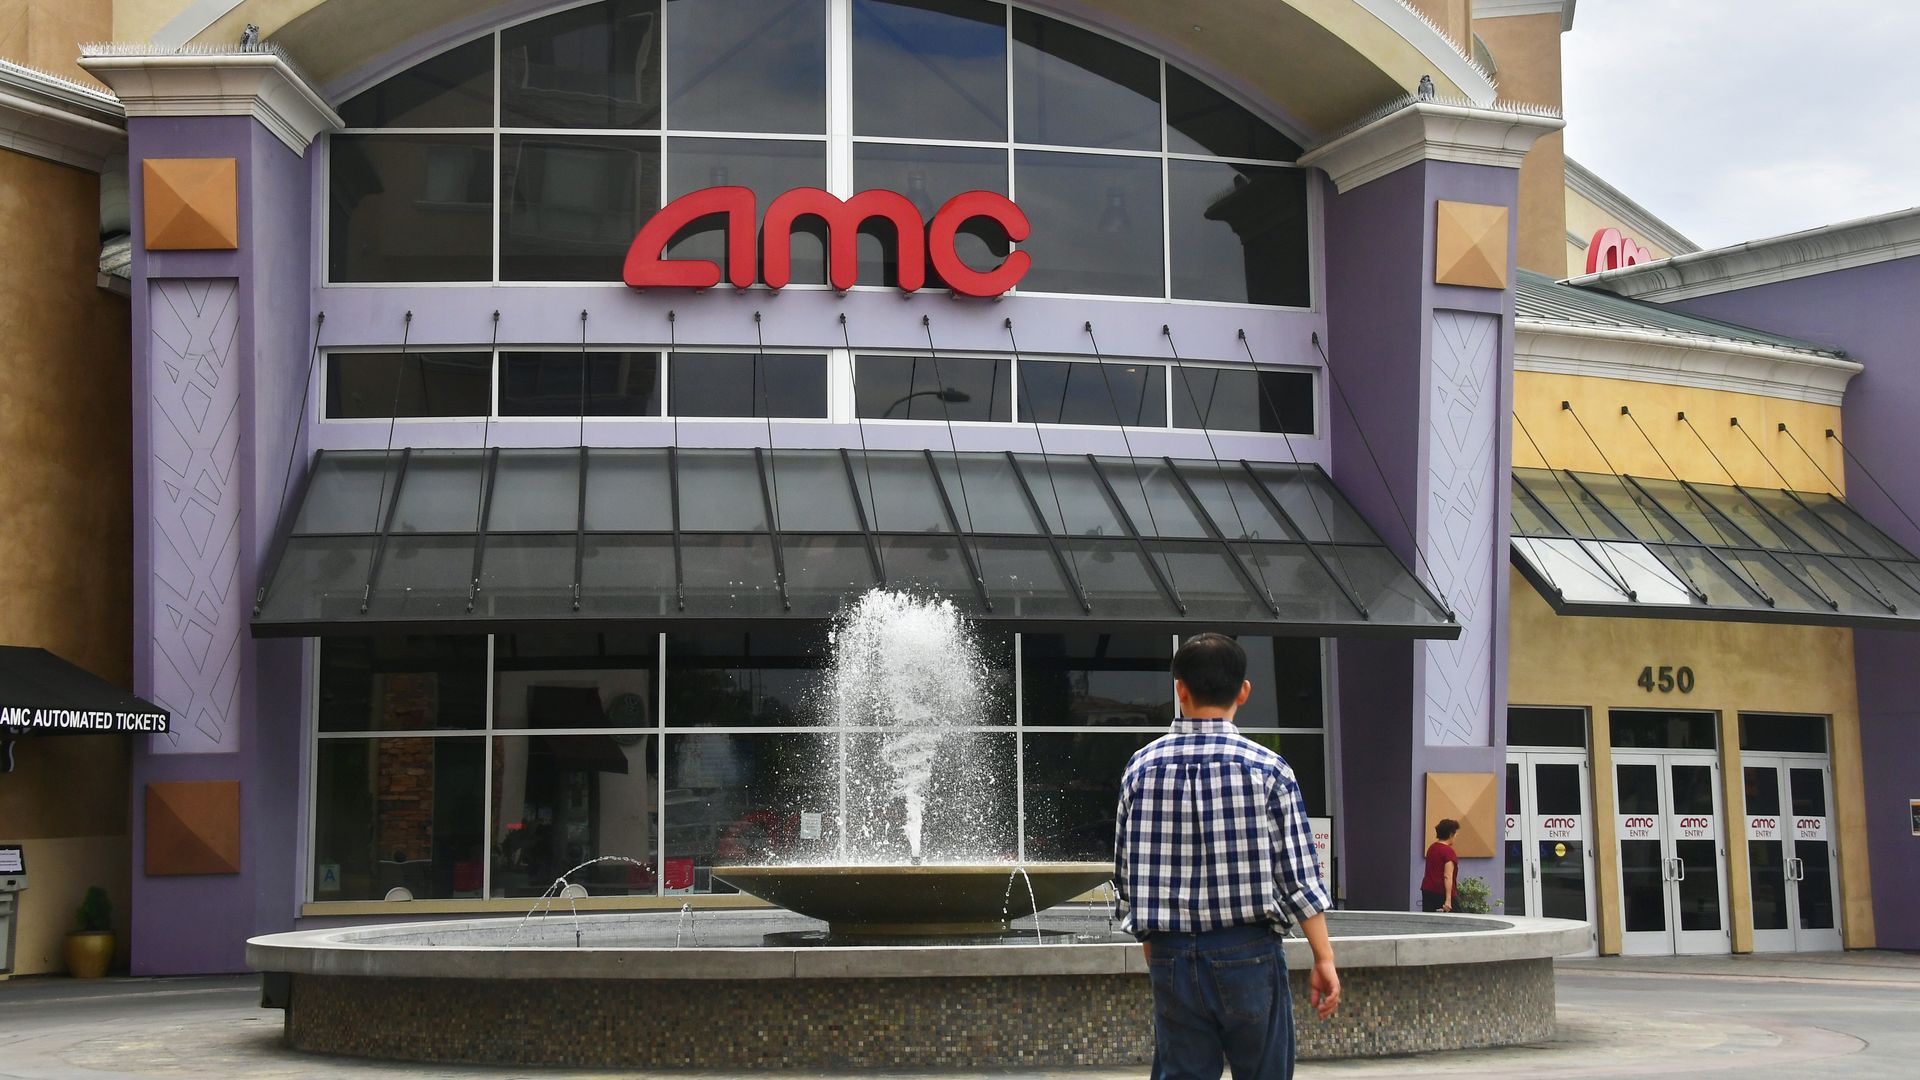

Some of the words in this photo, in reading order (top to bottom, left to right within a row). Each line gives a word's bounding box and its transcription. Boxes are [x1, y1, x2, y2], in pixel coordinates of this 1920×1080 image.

[1637, 666, 1695, 693] 450
[0, 707, 31, 726] AMC
[33, 709, 113, 729] AUTOMATED
[116, 713, 166, 731] TICKETS
[324, 869, 336, 881] A
